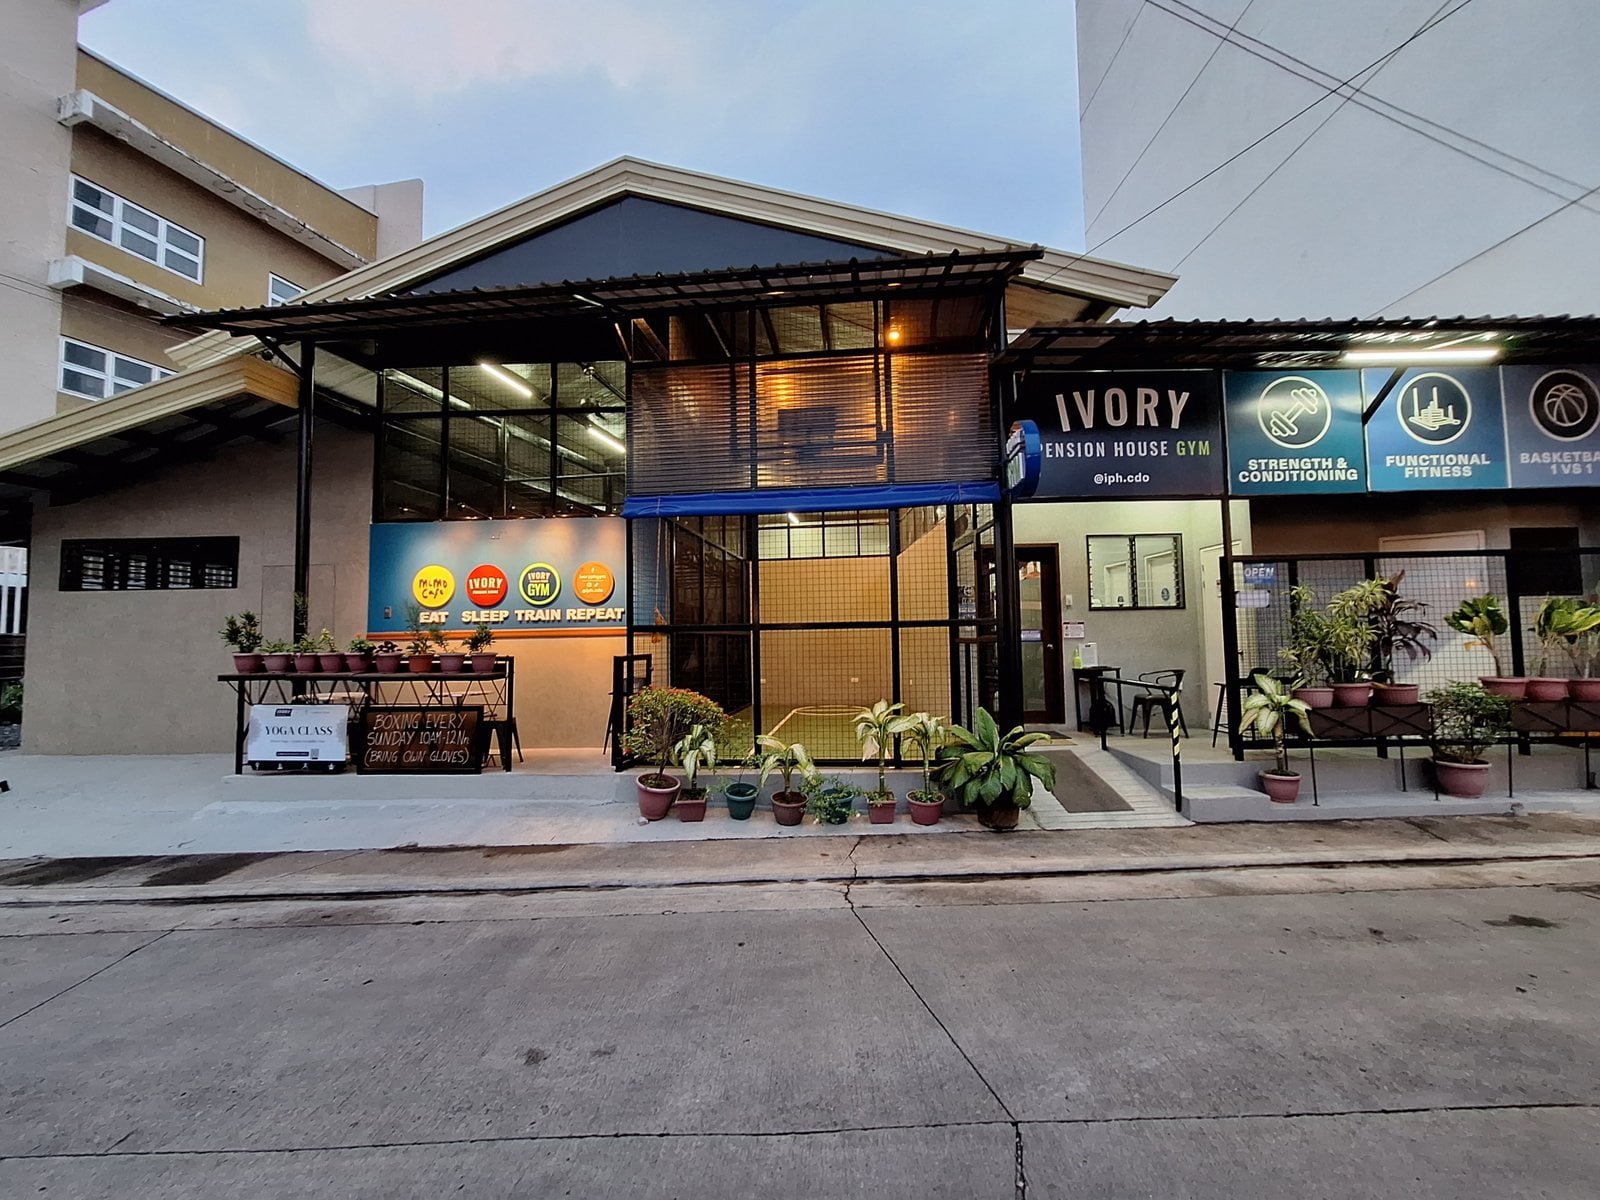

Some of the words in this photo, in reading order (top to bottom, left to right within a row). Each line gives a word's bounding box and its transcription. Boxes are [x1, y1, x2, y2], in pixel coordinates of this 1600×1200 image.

[1055, 387, 1190, 432] IVORY
[1040, 441, 1105, 458] ENSION
[1114, 441, 1169, 457] HOUSE
[1176, 440, 1210, 456] GYM
[1248, 458, 1332, 470] STRENGTH
[1336, 457, 1348, 469] &
[1386, 454, 1490, 467] FUNCTIONAL
[1238, 469, 1358, 482] CONDITIONING
[1404, 466, 1473, 478] FITNESS
[1550, 464, 1558, 475] 1
[1585, 463, 1593, 474] 1
[1093, 472, 1150, 485] @iph.cdo
[528, 571, 551, 580] IVORY
[1244, 567, 1275, 577] OPEN
[469, 577, 503, 589] IVORY
[527, 583, 550, 596] GYM
[419, 611, 449, 623] EAT
[461, 610, 510, 623] SLEEP
[514, 608, 562, 621] TRAIN
[566, 607, 625, 621] REPEAT
[373, 713, 420, 730] BOXING
[425, 713, 467, 729] EVERY
[265, 725, 295, 736] YOGA
[298, 725, 333, 736] CLASS
[367, 730, 416, 746] SUNDAY
